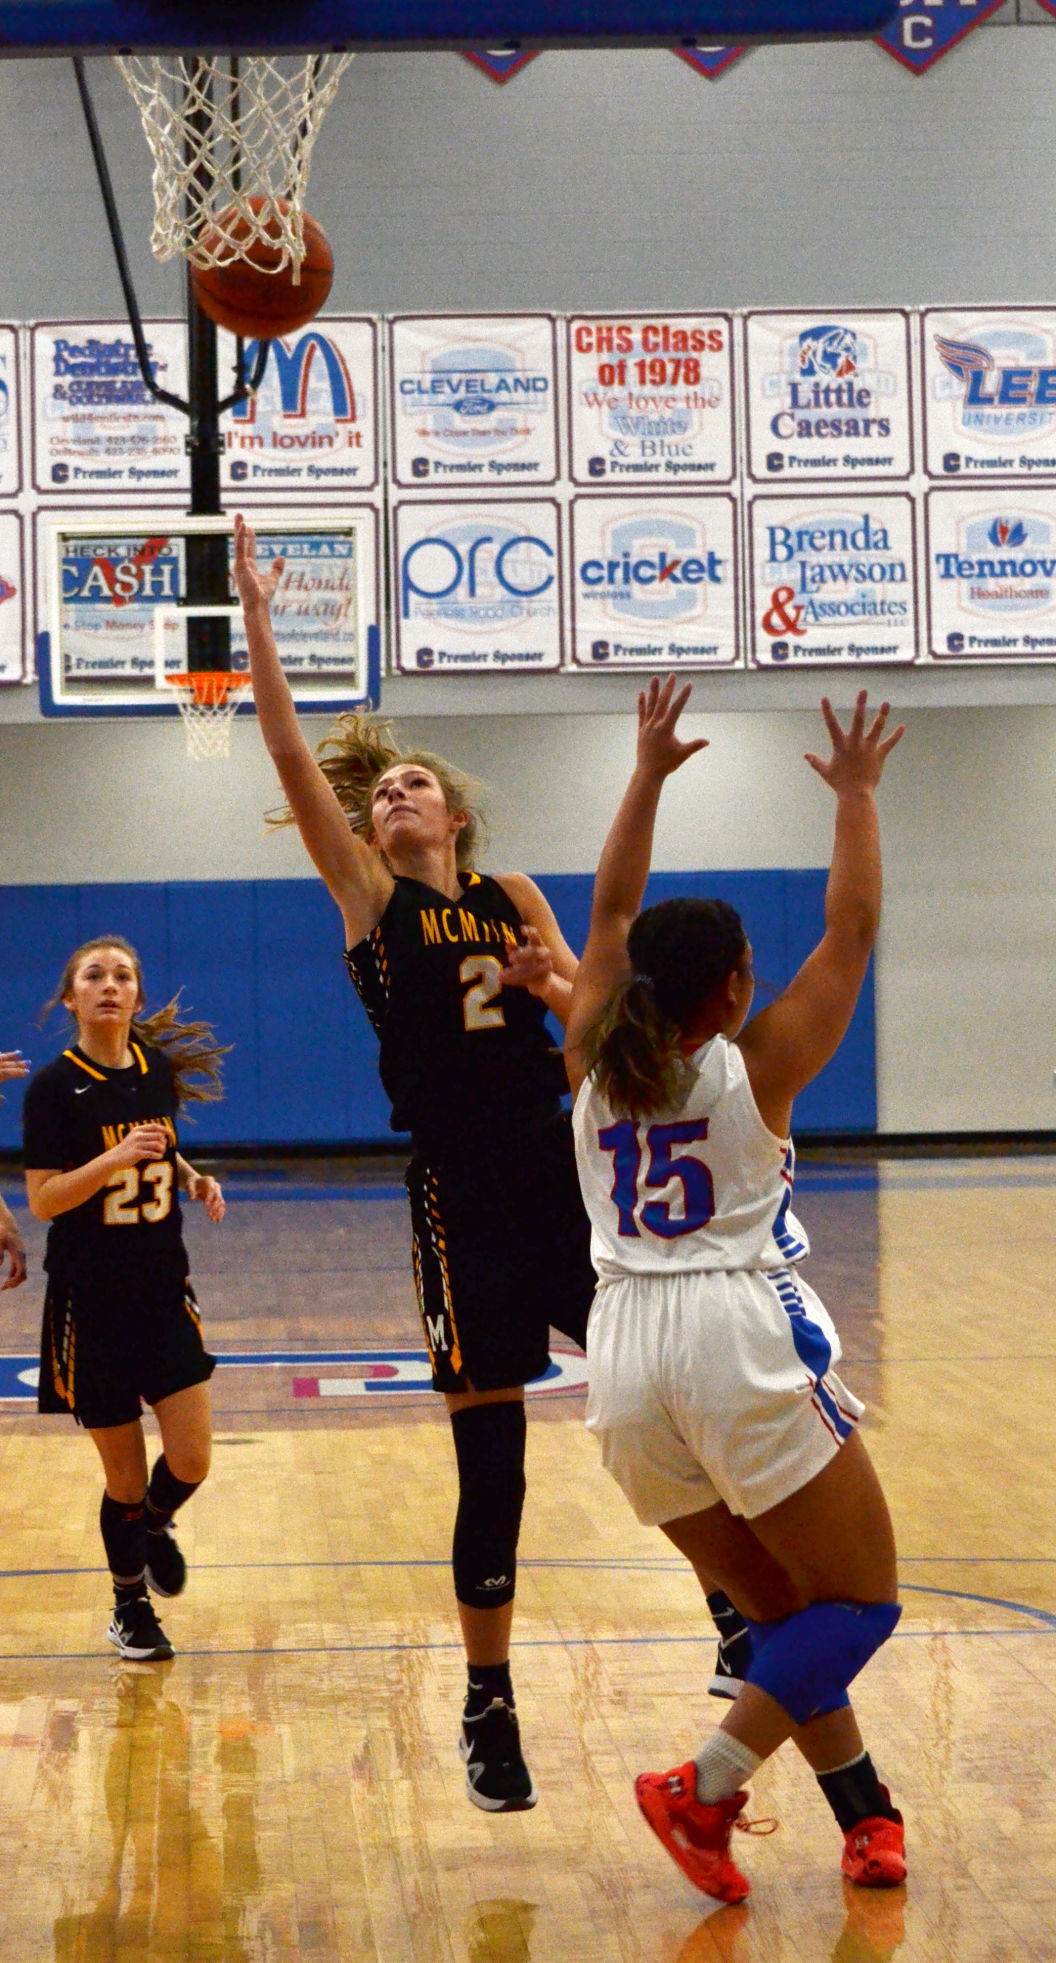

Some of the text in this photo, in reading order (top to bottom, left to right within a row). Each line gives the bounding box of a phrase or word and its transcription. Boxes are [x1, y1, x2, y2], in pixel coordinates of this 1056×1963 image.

[575, 325, 723, 353] CHS Class
[598, 357, 701, 386] of 1978
[400, 377, 548, 395] CLEVELAND
[788, 381, 871, 409] Little
[582, 391, 721, 410] We love the
[613, 415, 688, 436] White
[771, 412, 891, 439] Caesars
[227, 431, 363, 448] I'm lovin' it
[609, 440, 693, 457] & Blue
[434, 461, 484, 473] Premier
[488, 460, 540, 475] Sponsor
[610, 460, 661, 472] Premier
[665, 459, 716, 475] Sponsor
[788, 456, 839, 468] Premier
[843, 454, 894, 470] Sponsor
[965, 456, 1014, 468] Premier
[73, 467, 124, 479] Premier
[128, 467, 179, 482] Sponsor
[252, 465, 302, 477] Premier
[307, 464, 358, 480] Sponsor
[766, 514, 891, 563] Brenda
[65, 545, 119, 557] HECK
[580, 551, 723, 585] cricket
[935, 553, 1056, 579] Tennov
[402, 536, 554, 619] prc
[798, 560, 908, 594] Lawson
[582, 591, 632, 600] wireless
[970, 586, 1050, 600] Healthcare
[762, 586, 908, 637] & Associates
[613, 644, 663, 656] Premier
[668, 643, 719, 658] Sponsor
[968, 635, 1019, 648] Premier
[438, 652, 488, 663] Premier
[492, 650, 544, 665] Sponsor
[793, 645, 843, 657] Premier
[847, 644, 899, 658] Sponsor
[76, 658, 127, 669] Premier
[131, 657, 182, 672] Sposor
[459, 955, 506, 1031] 2
[598, 1118, 715, 1239] 15
[104, 1161, 174, 1225] 23
[426, 1313, 449, 1352] M
